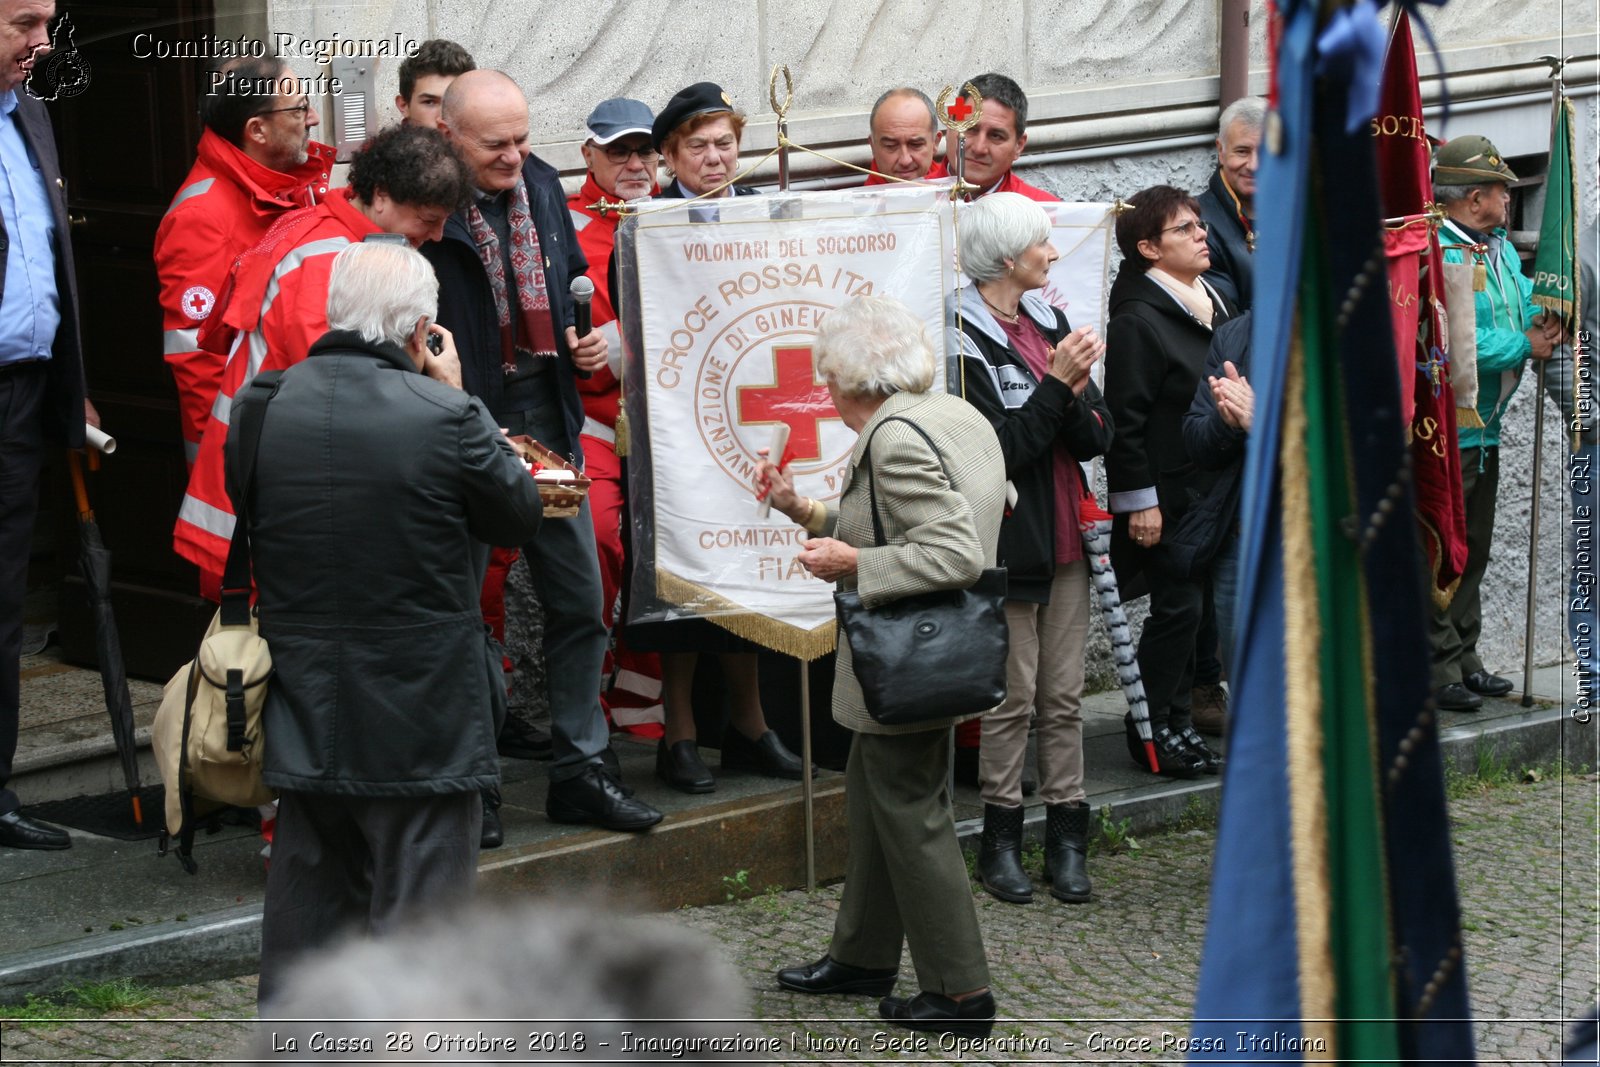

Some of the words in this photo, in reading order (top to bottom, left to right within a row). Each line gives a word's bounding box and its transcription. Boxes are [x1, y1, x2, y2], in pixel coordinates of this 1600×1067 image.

[683, 240, 769, 262] VOLONTARI
[778, 238, 808, 257] DEL
[816, 232, 897, 256] SOCCORSO
[656, 294, 720, 389] CROCE
[717, 262, 824, 306] ROSSA
[831, 267, 884, 297] ITA
[725, 327, 750, 351] DI
[1002, 381, 1030, 391] Zeus
[758, 557, 816, 581] FIA
